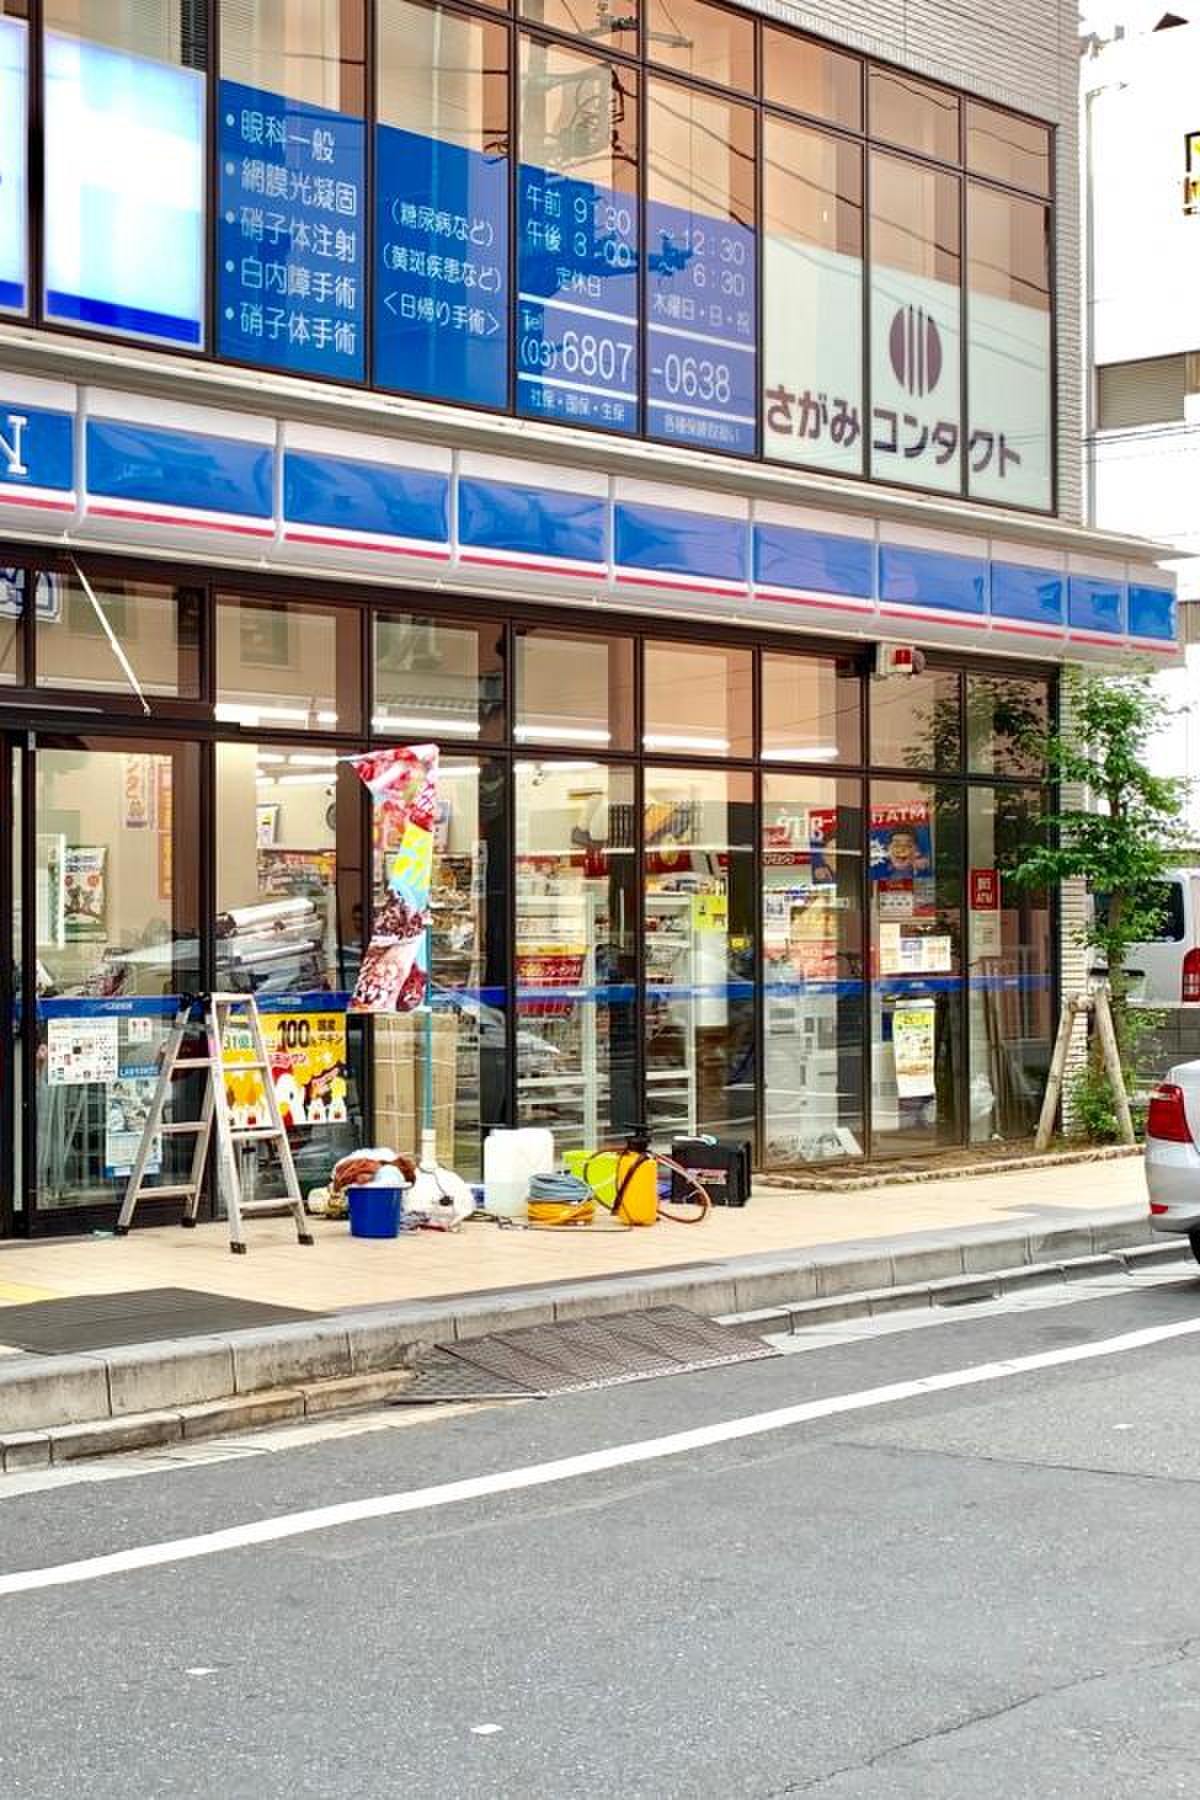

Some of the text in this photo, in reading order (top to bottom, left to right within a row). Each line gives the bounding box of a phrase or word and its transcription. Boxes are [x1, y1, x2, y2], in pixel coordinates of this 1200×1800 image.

[239, 109, 336, 164] 眼科一般
[240, 156, 358, 218] 網膜光凝固
[526, 185, 561, 219] 午前
[239, 204, 357, 263] 硝子体注射
[526, 219, 561, 252] 午後
[240, 256, 357, 311] 白内障手術
[556, 266, 602, 298] 定休日
[239, 301, 357, 356] 硝子体手術
